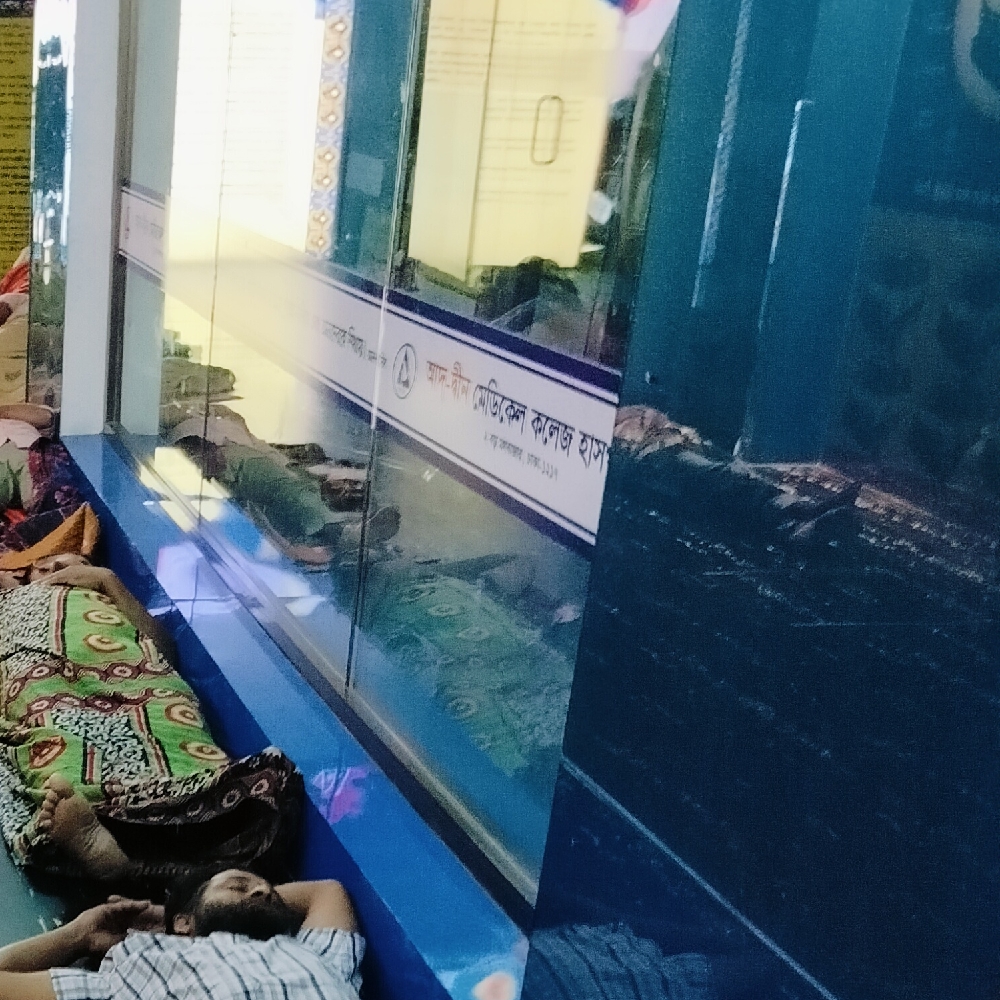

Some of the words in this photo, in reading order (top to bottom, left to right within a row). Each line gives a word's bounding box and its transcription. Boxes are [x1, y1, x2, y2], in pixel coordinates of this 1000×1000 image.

[473, 379, 528, 436] মেডিকেল
[531, 408, 576, 458] কলেজ
[578, 430, 611, 473] হাস
